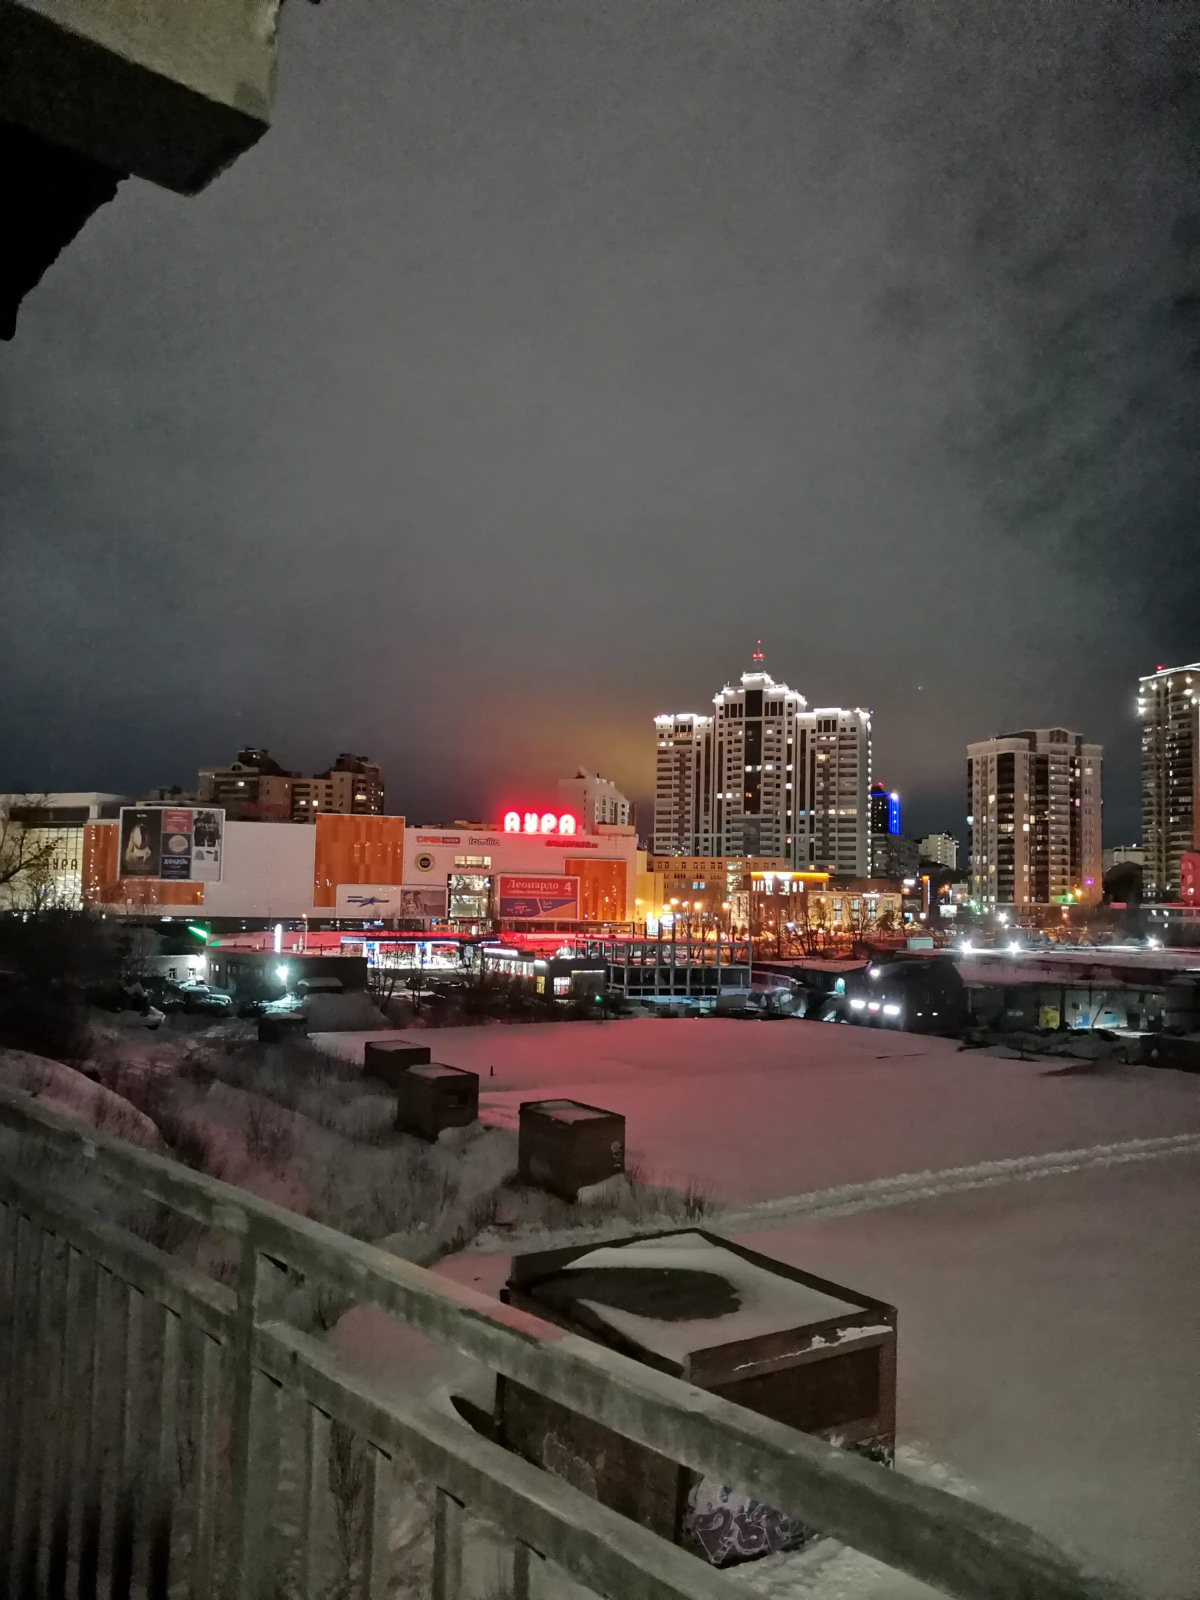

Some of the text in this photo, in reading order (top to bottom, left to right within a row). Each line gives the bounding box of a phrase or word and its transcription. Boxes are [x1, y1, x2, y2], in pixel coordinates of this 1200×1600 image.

[504, 811, 576, 834] АУРА
[468, 836, 501, 847] familia
[507, 879, 559, 891] Леонардо
[563, 882, 572, 892] 4
